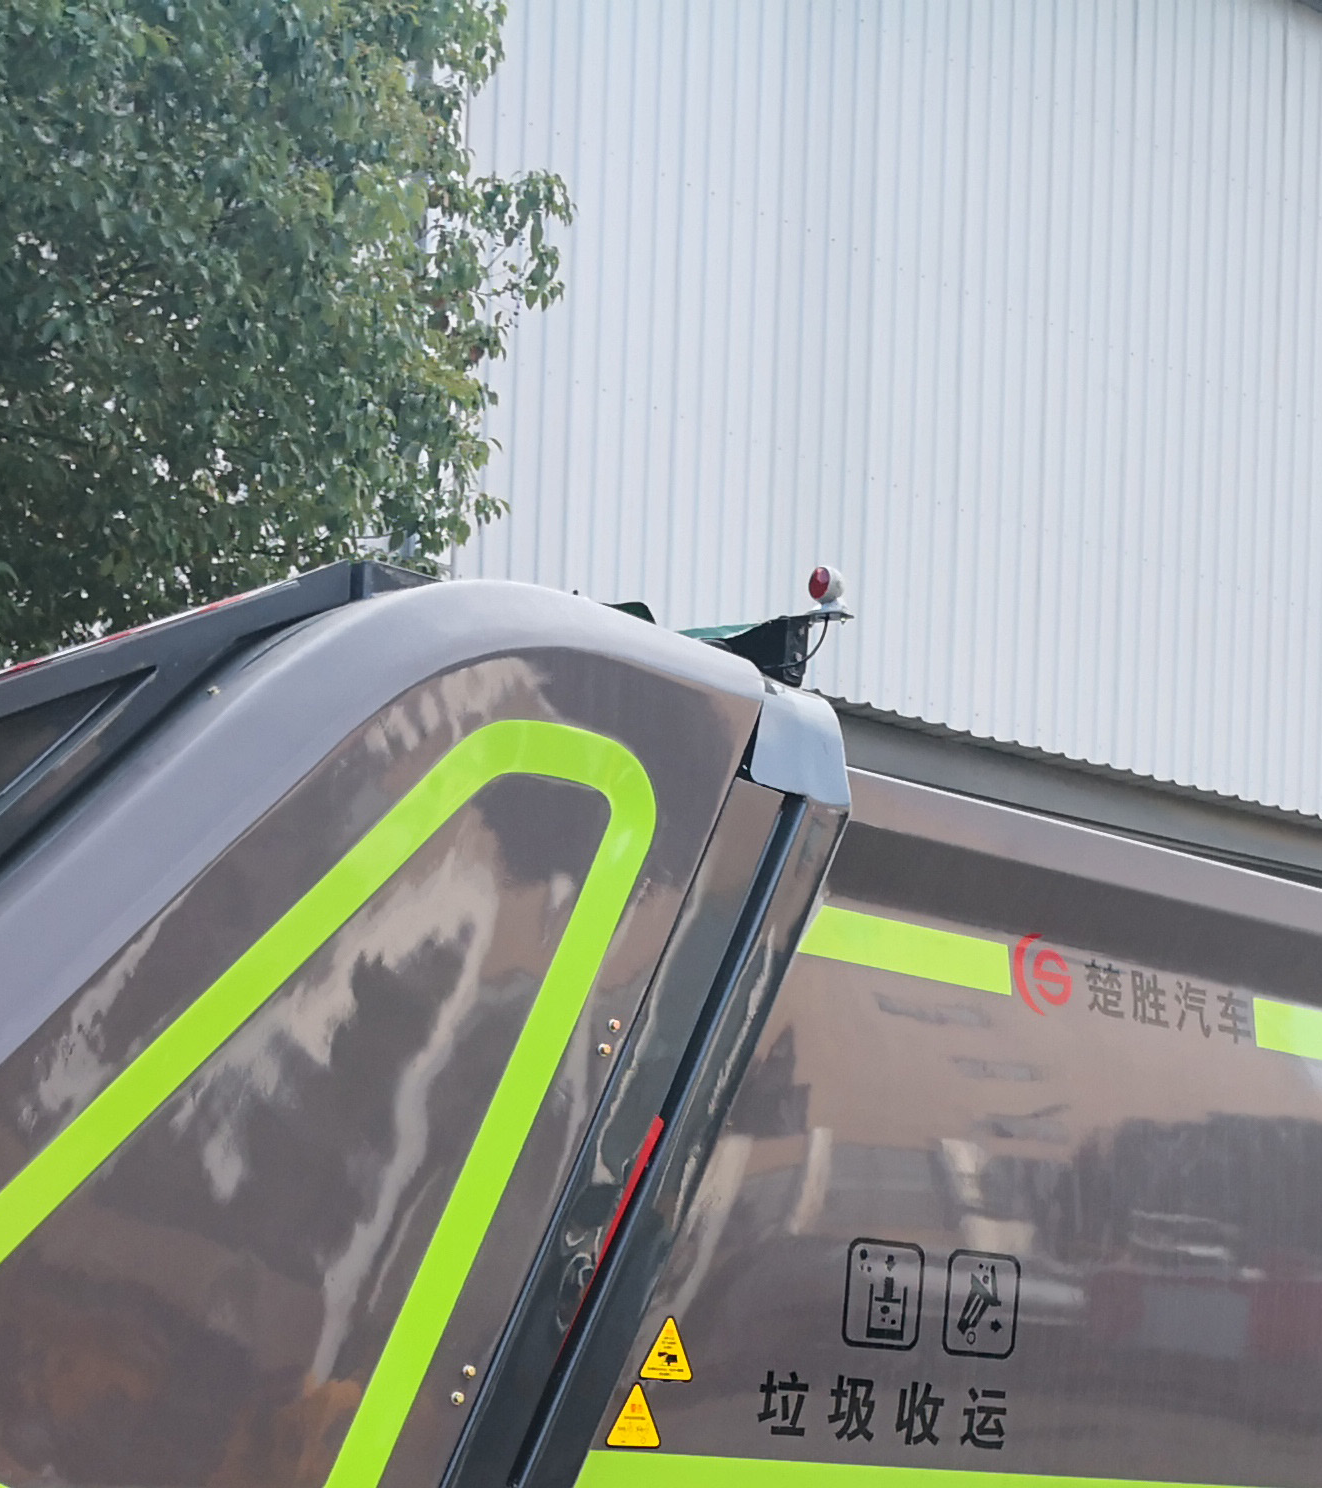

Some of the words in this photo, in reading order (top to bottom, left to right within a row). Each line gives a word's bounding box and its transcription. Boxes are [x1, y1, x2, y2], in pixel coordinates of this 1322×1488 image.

[1084, 958, 1253, 1045] 楚胜汽车
[757, 1369, 1008, 1451] 垃圾收运
